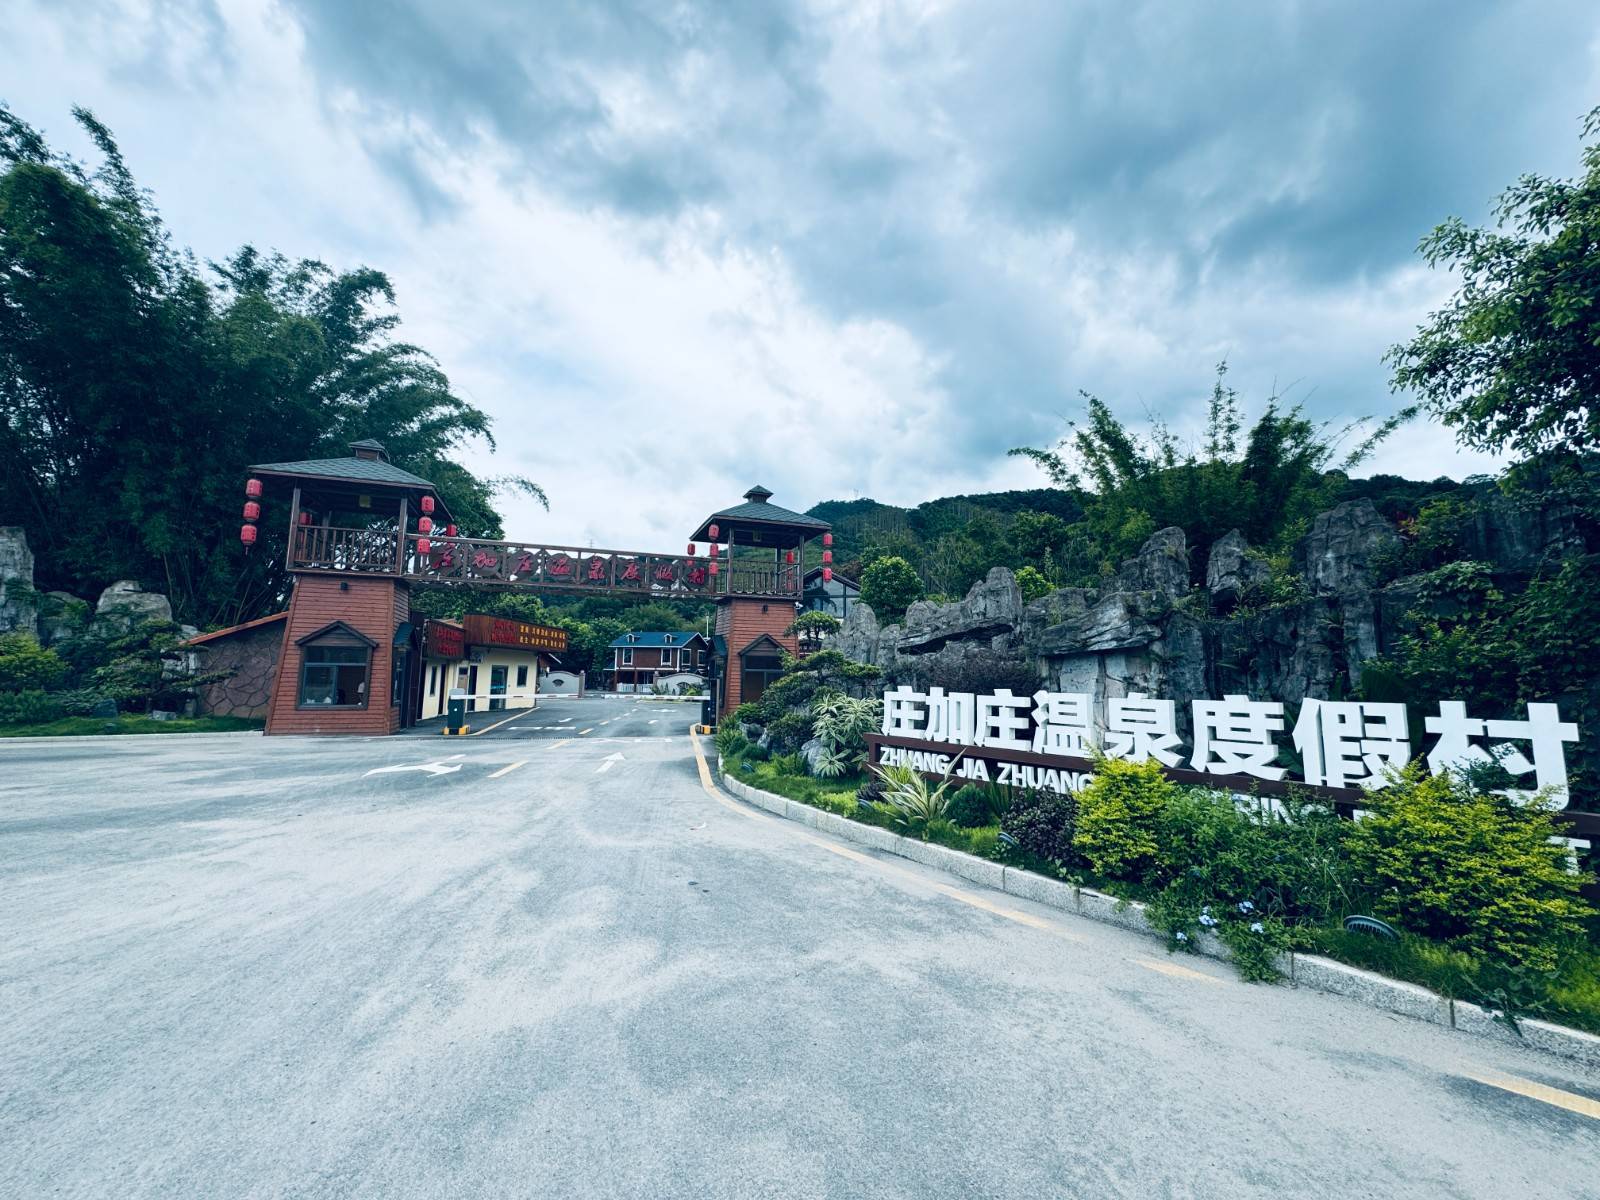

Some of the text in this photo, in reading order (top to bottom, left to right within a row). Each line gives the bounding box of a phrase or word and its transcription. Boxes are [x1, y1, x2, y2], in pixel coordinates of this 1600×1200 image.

[881, 685, 1580, 812] 庄加庄温泉度假村
[956, 757, 990, 782] JIA
